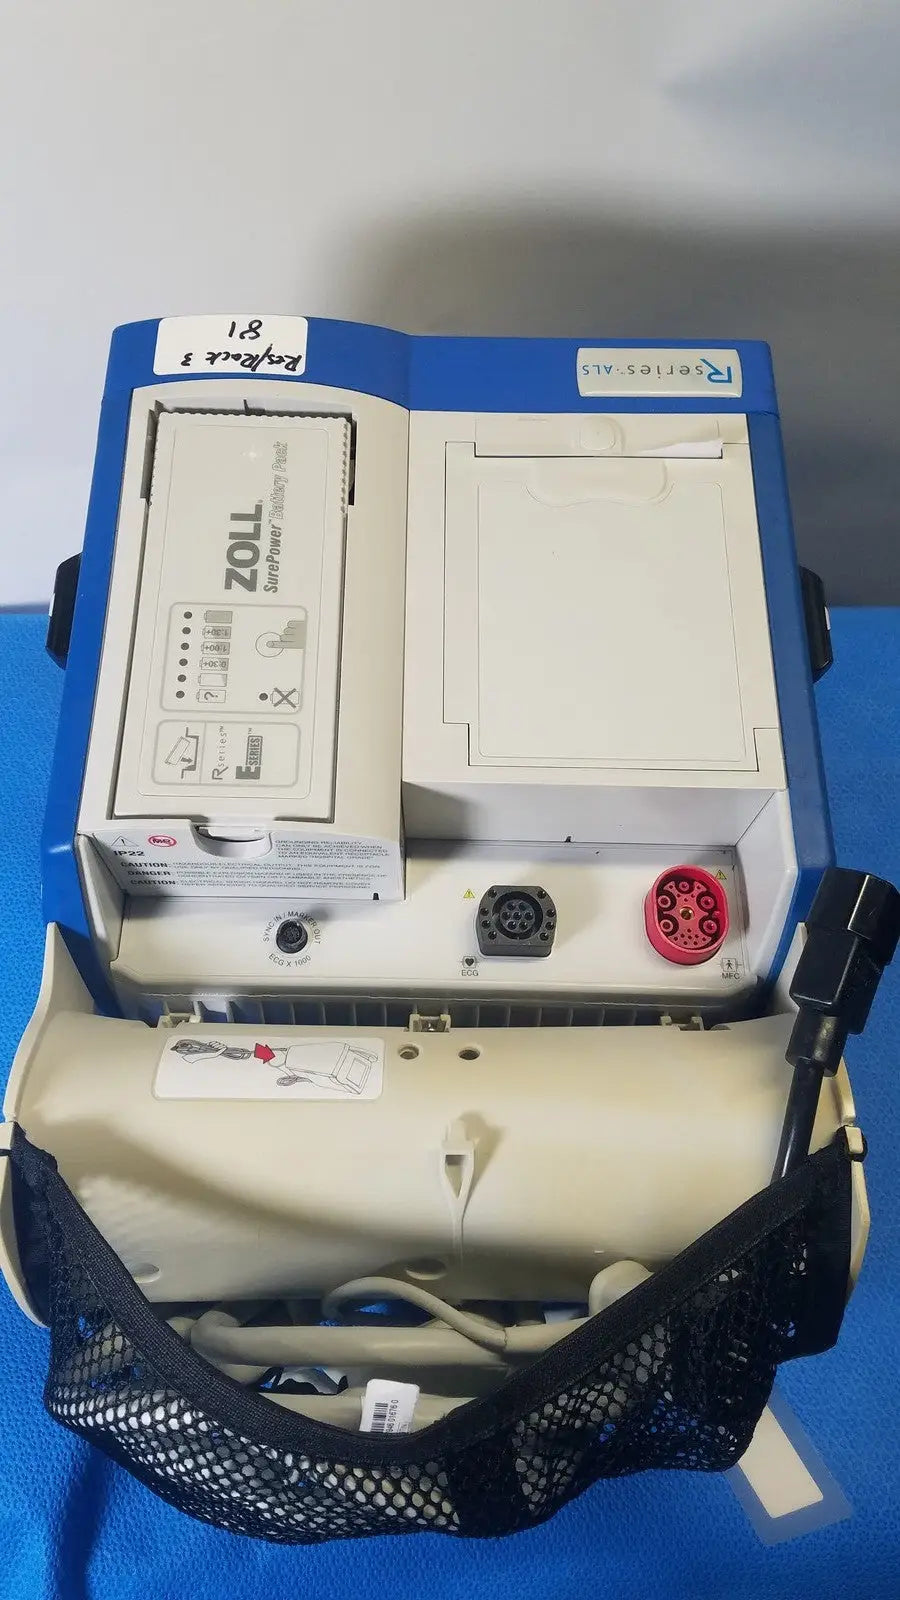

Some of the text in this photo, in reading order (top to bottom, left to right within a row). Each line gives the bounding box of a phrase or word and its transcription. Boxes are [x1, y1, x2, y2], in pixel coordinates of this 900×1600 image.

[228, 319, 263, 340] 81
[180, 352, 193, 366] 3
[272, 441, 288, 472] Pack
[268, 475, 288, 520] Battery
[224, 502, 263, 593] ZOLL
[262, 921, 275, 942] SYNC
[288, 911, 318, 928] MARKER
[268, 953, 284, 966] ECG
[294, 955, 311, 967] 1000
